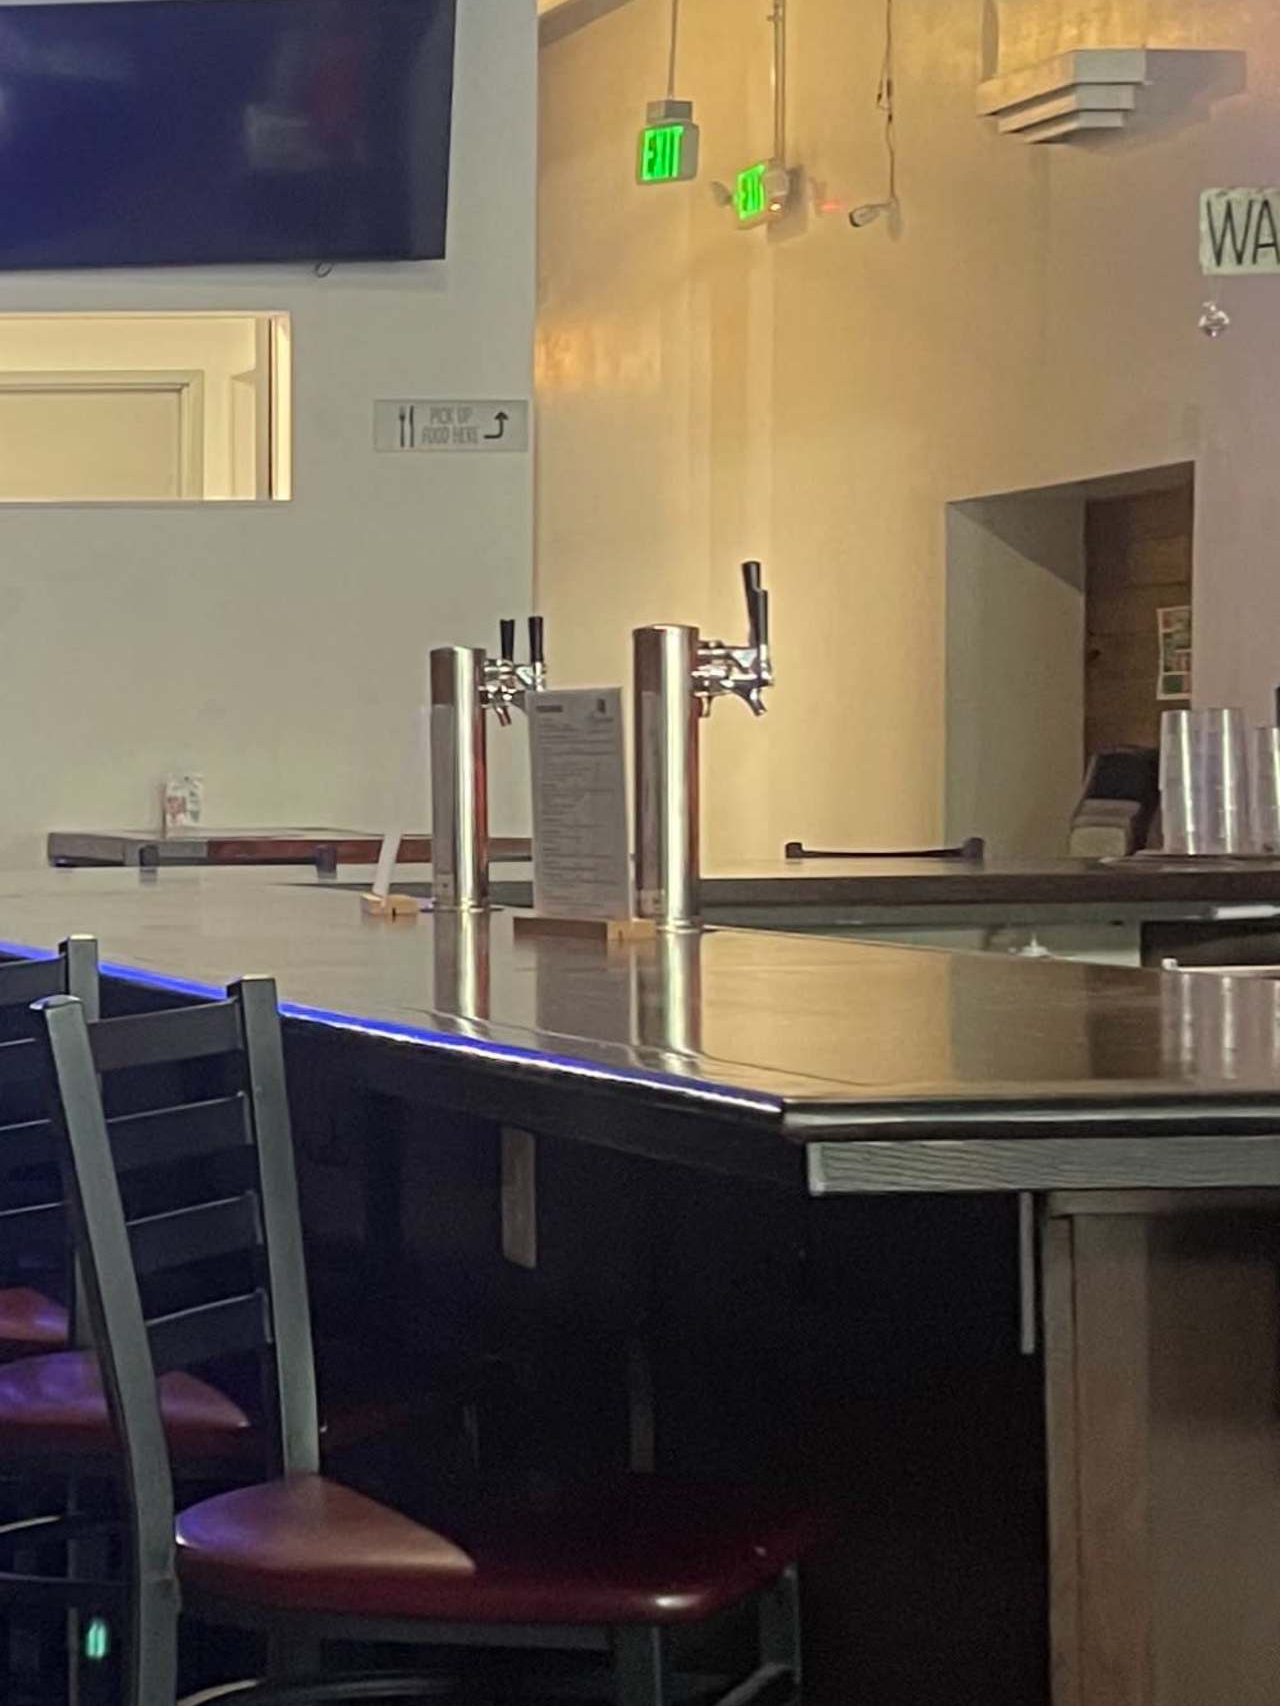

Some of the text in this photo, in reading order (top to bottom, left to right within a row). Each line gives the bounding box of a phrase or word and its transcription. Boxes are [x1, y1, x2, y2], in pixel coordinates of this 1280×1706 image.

[642, 126, 684, 181] EXIT
[738, 164, 766, 220] EXIT
[1206, 198, 1280, 266] WA
[457, 406, 474, 425] UP
